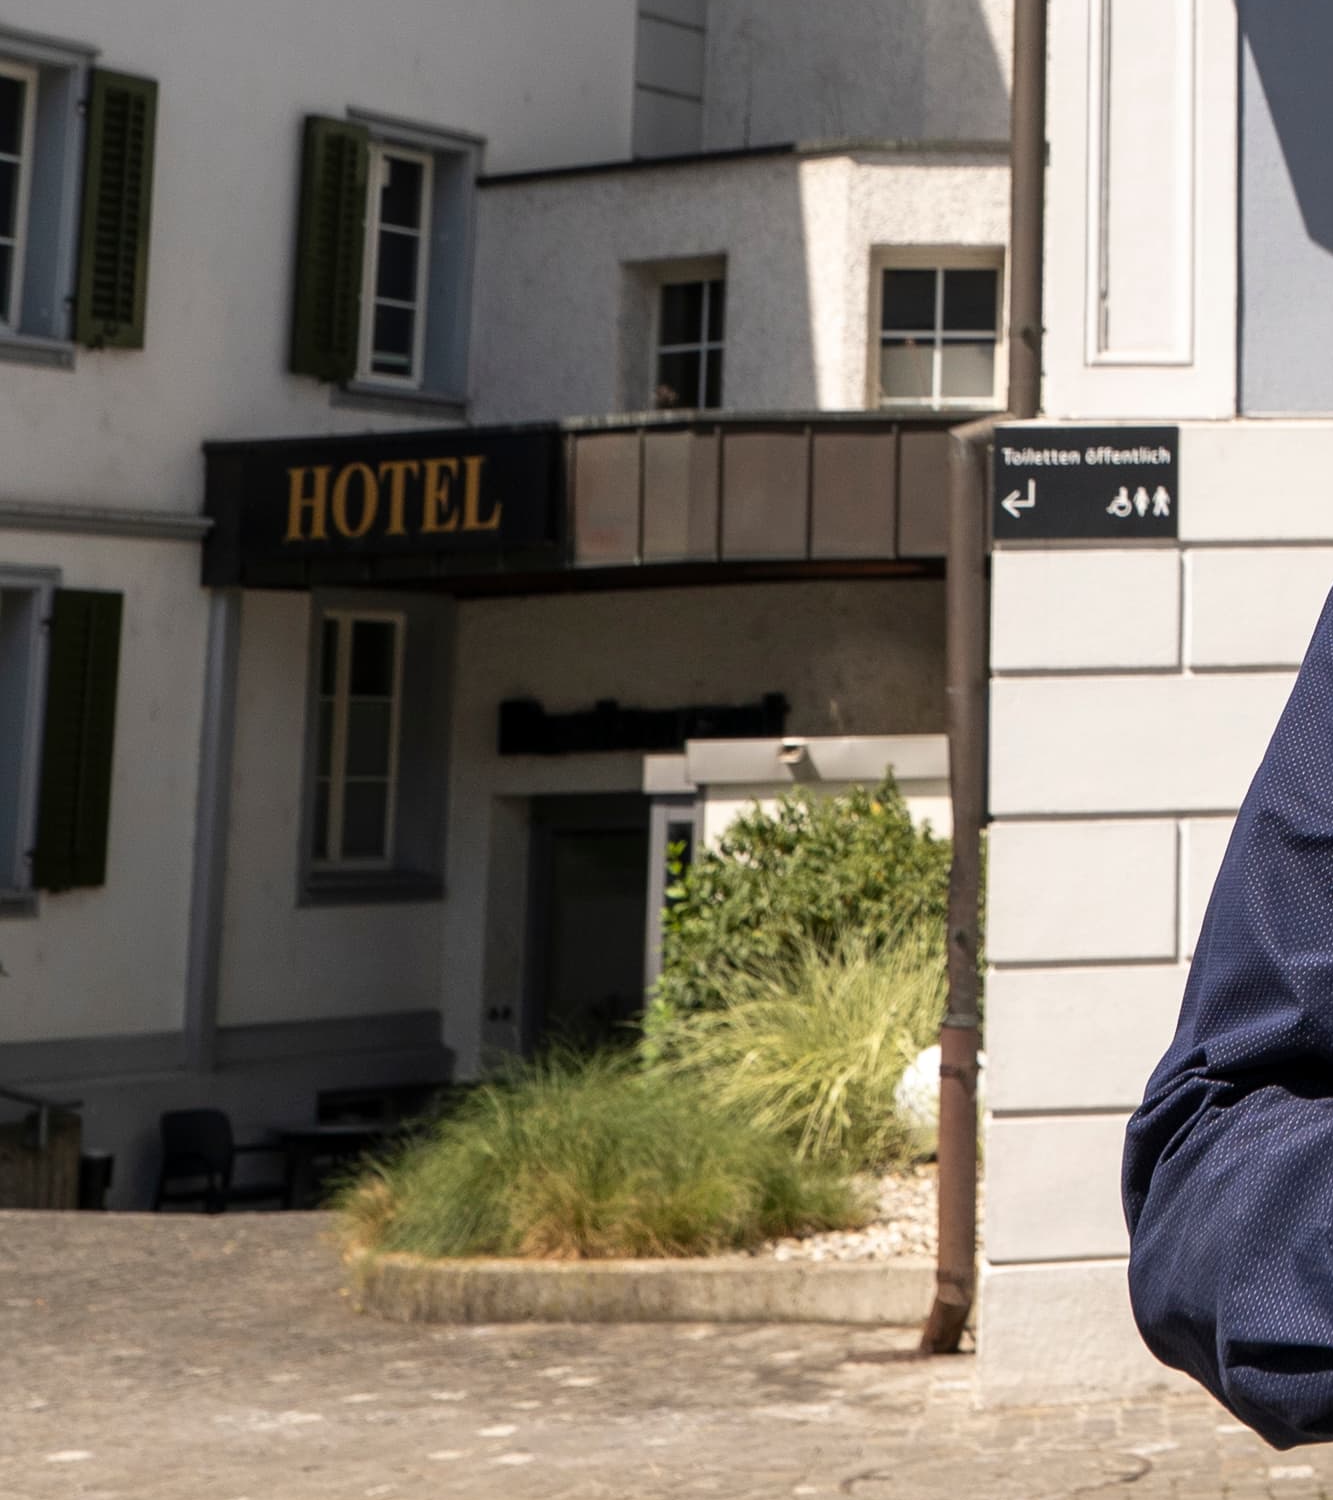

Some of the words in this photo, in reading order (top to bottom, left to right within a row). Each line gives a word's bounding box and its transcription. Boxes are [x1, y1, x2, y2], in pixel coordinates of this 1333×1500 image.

[1002, 447, 1081, 466] Toiletten
[1085, 446, 1172, 465] öffentlich
[284, 455, 502, 542] HOTEL
